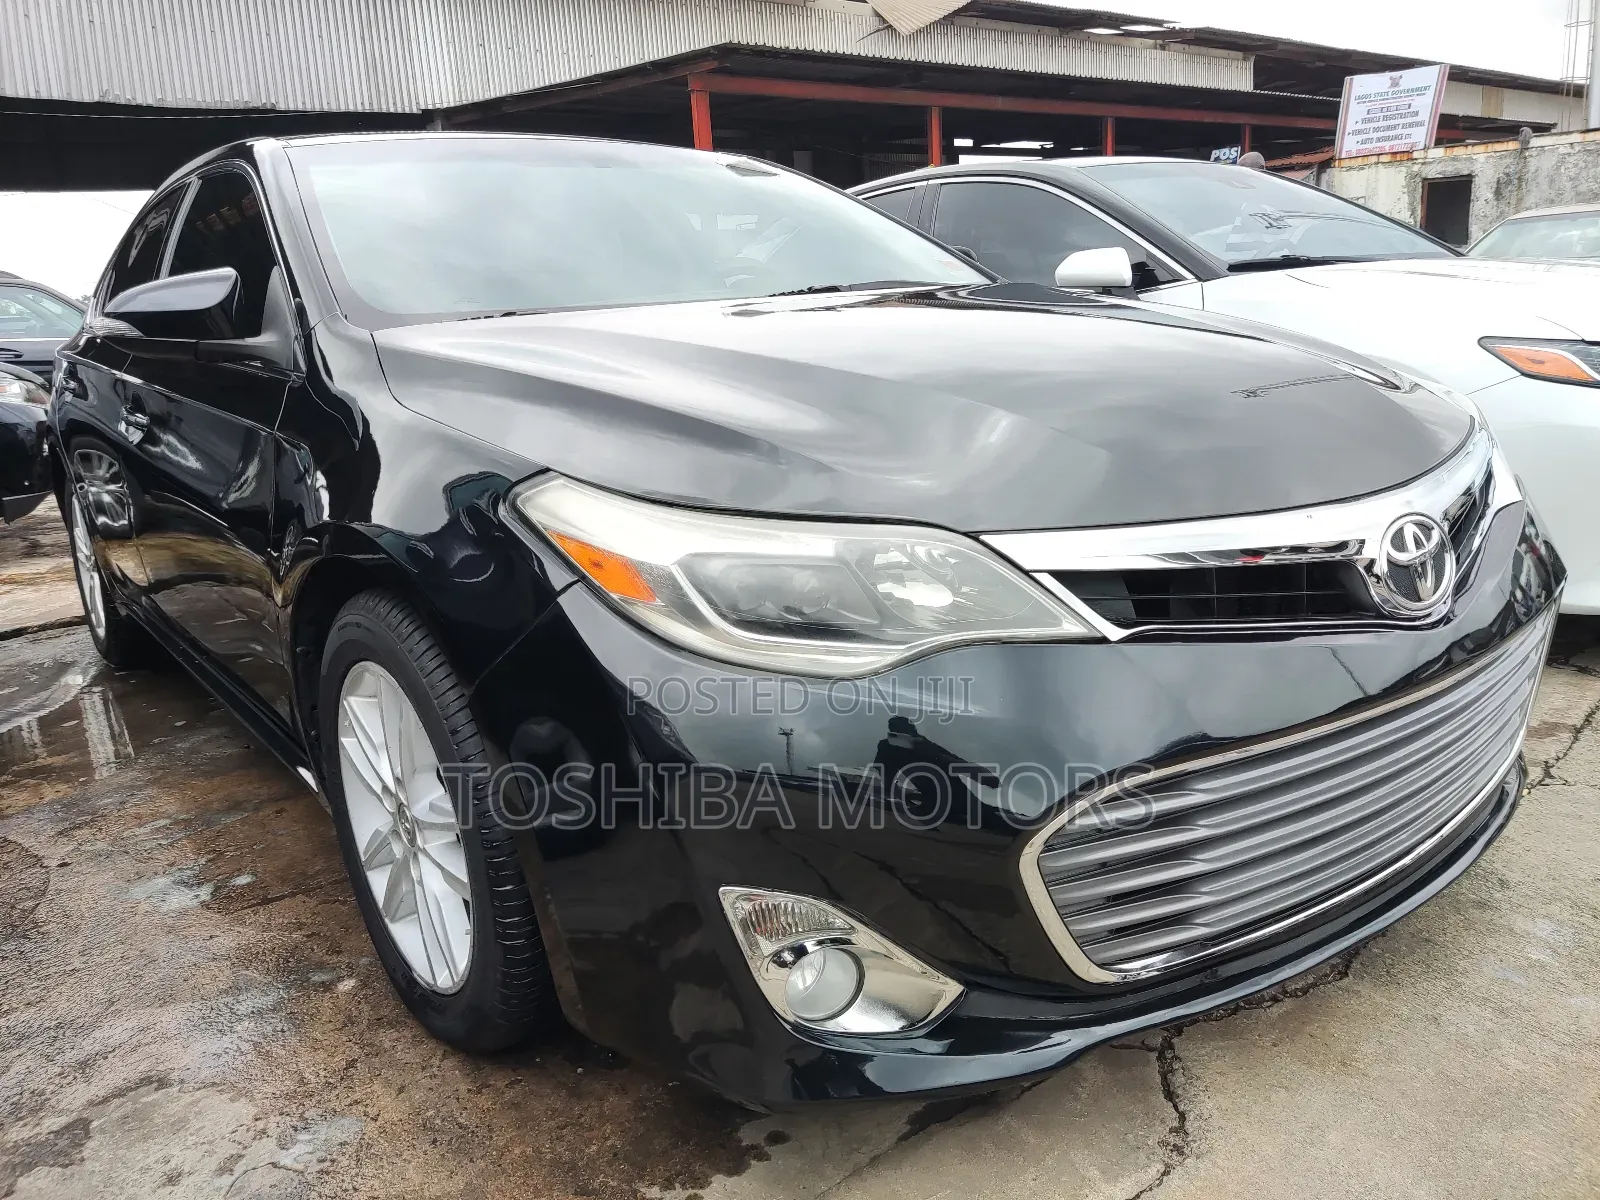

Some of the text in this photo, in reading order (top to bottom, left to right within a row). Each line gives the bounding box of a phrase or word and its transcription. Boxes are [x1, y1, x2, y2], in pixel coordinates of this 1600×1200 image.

[1390, 85, 1431, 96] GOVERNMENT
[1361, 110, 1420, 125] VEHICLE REGISTRATION
[1351, 120, 1426, 136] VEHICLE DOCUMENT RENEWAL
[1360, 137, 1374, 145] AUTO
[1375, 134, 1404, 143] INSURANCE
[1210, 147, 1239, 162] POS
